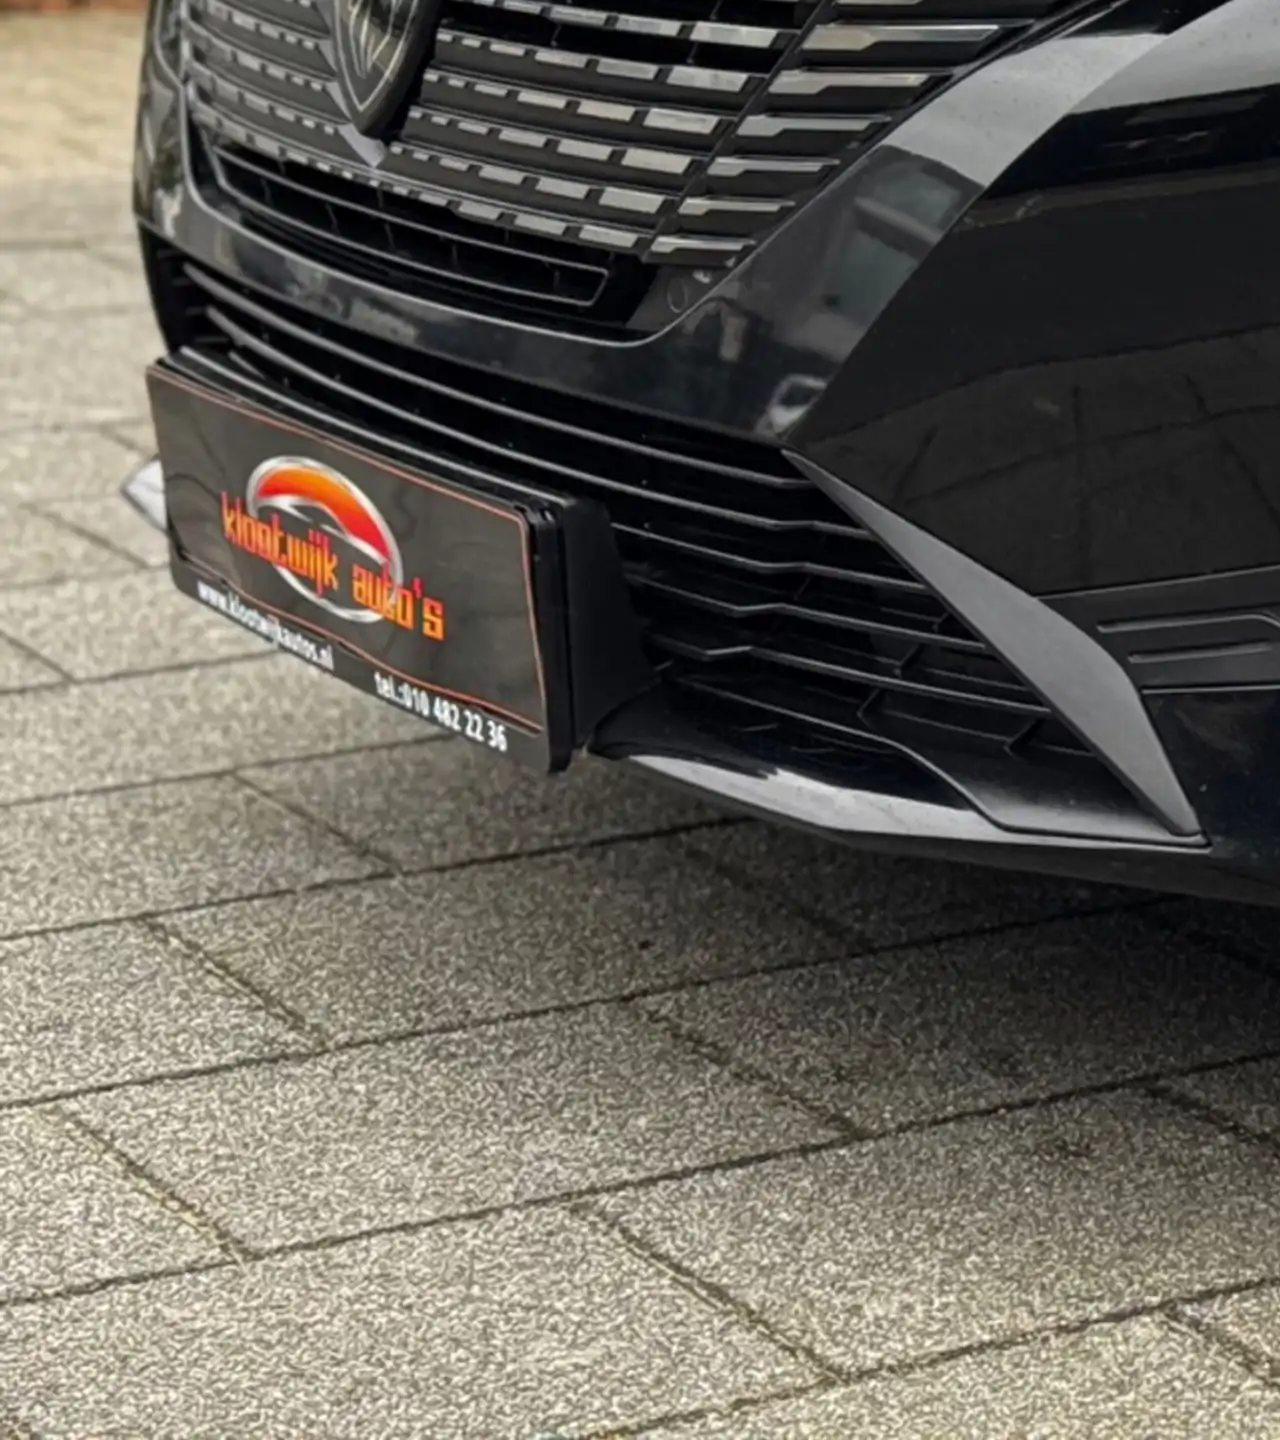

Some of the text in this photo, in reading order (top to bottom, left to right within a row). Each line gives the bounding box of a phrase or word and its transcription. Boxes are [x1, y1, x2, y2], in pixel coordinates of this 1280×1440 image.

[220, 490, 444, 641] klootwijk auto's
[433, 696, 462, 735] 482
[464, 710, 485, 742] 22
[487, 720, 508, 752] 36
